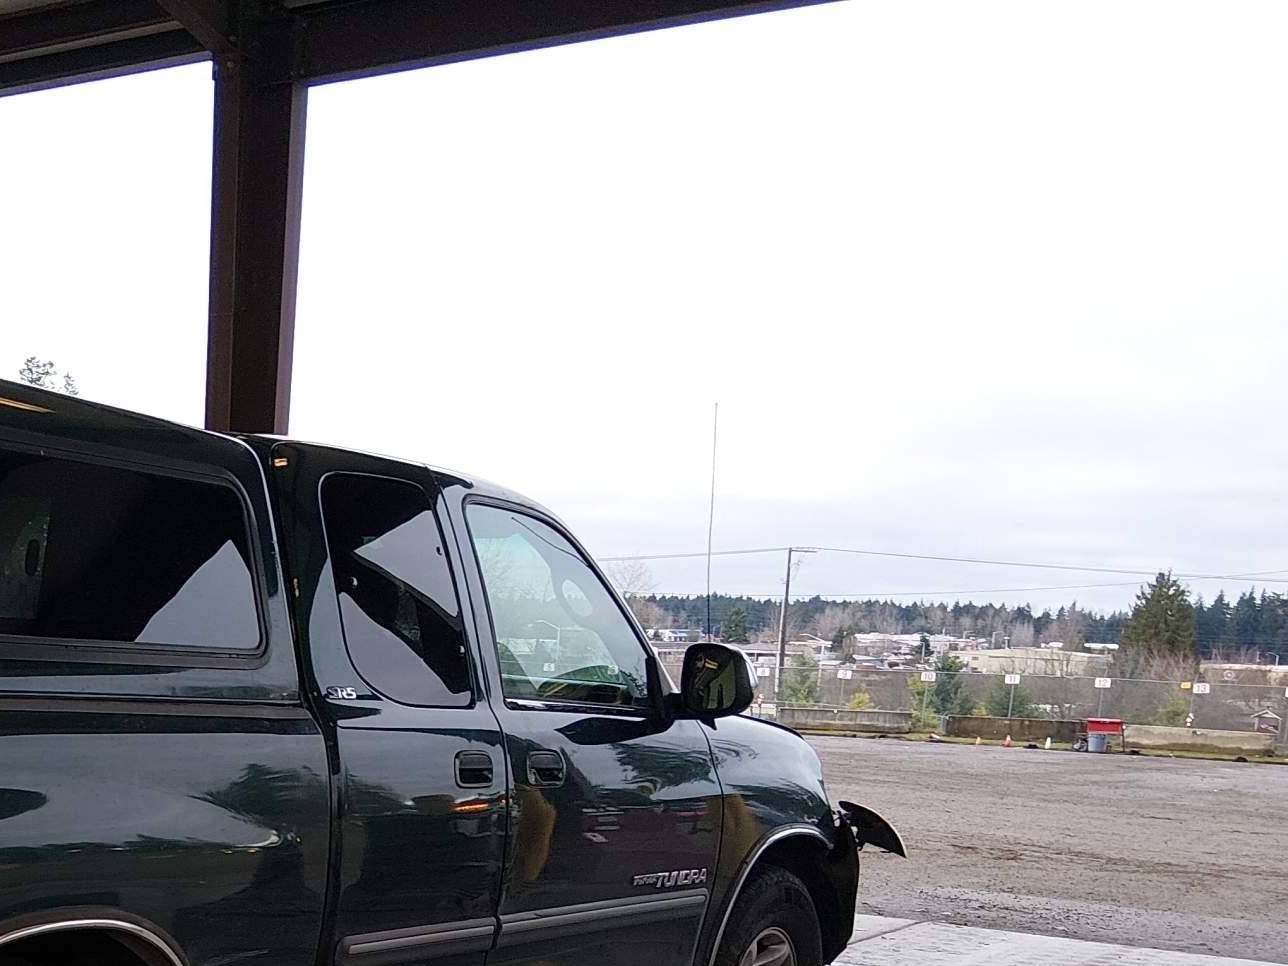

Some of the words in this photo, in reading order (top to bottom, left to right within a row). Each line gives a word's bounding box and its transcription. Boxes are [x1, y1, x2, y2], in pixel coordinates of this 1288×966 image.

[924, 672, 934, 681] 10
[1009, 675, 1017, 684] 11
[1099, 678, 1108, 688] 12
[1197, 683, 1207, 693] 13
[655, 868, 708, 888] TUNDRA
